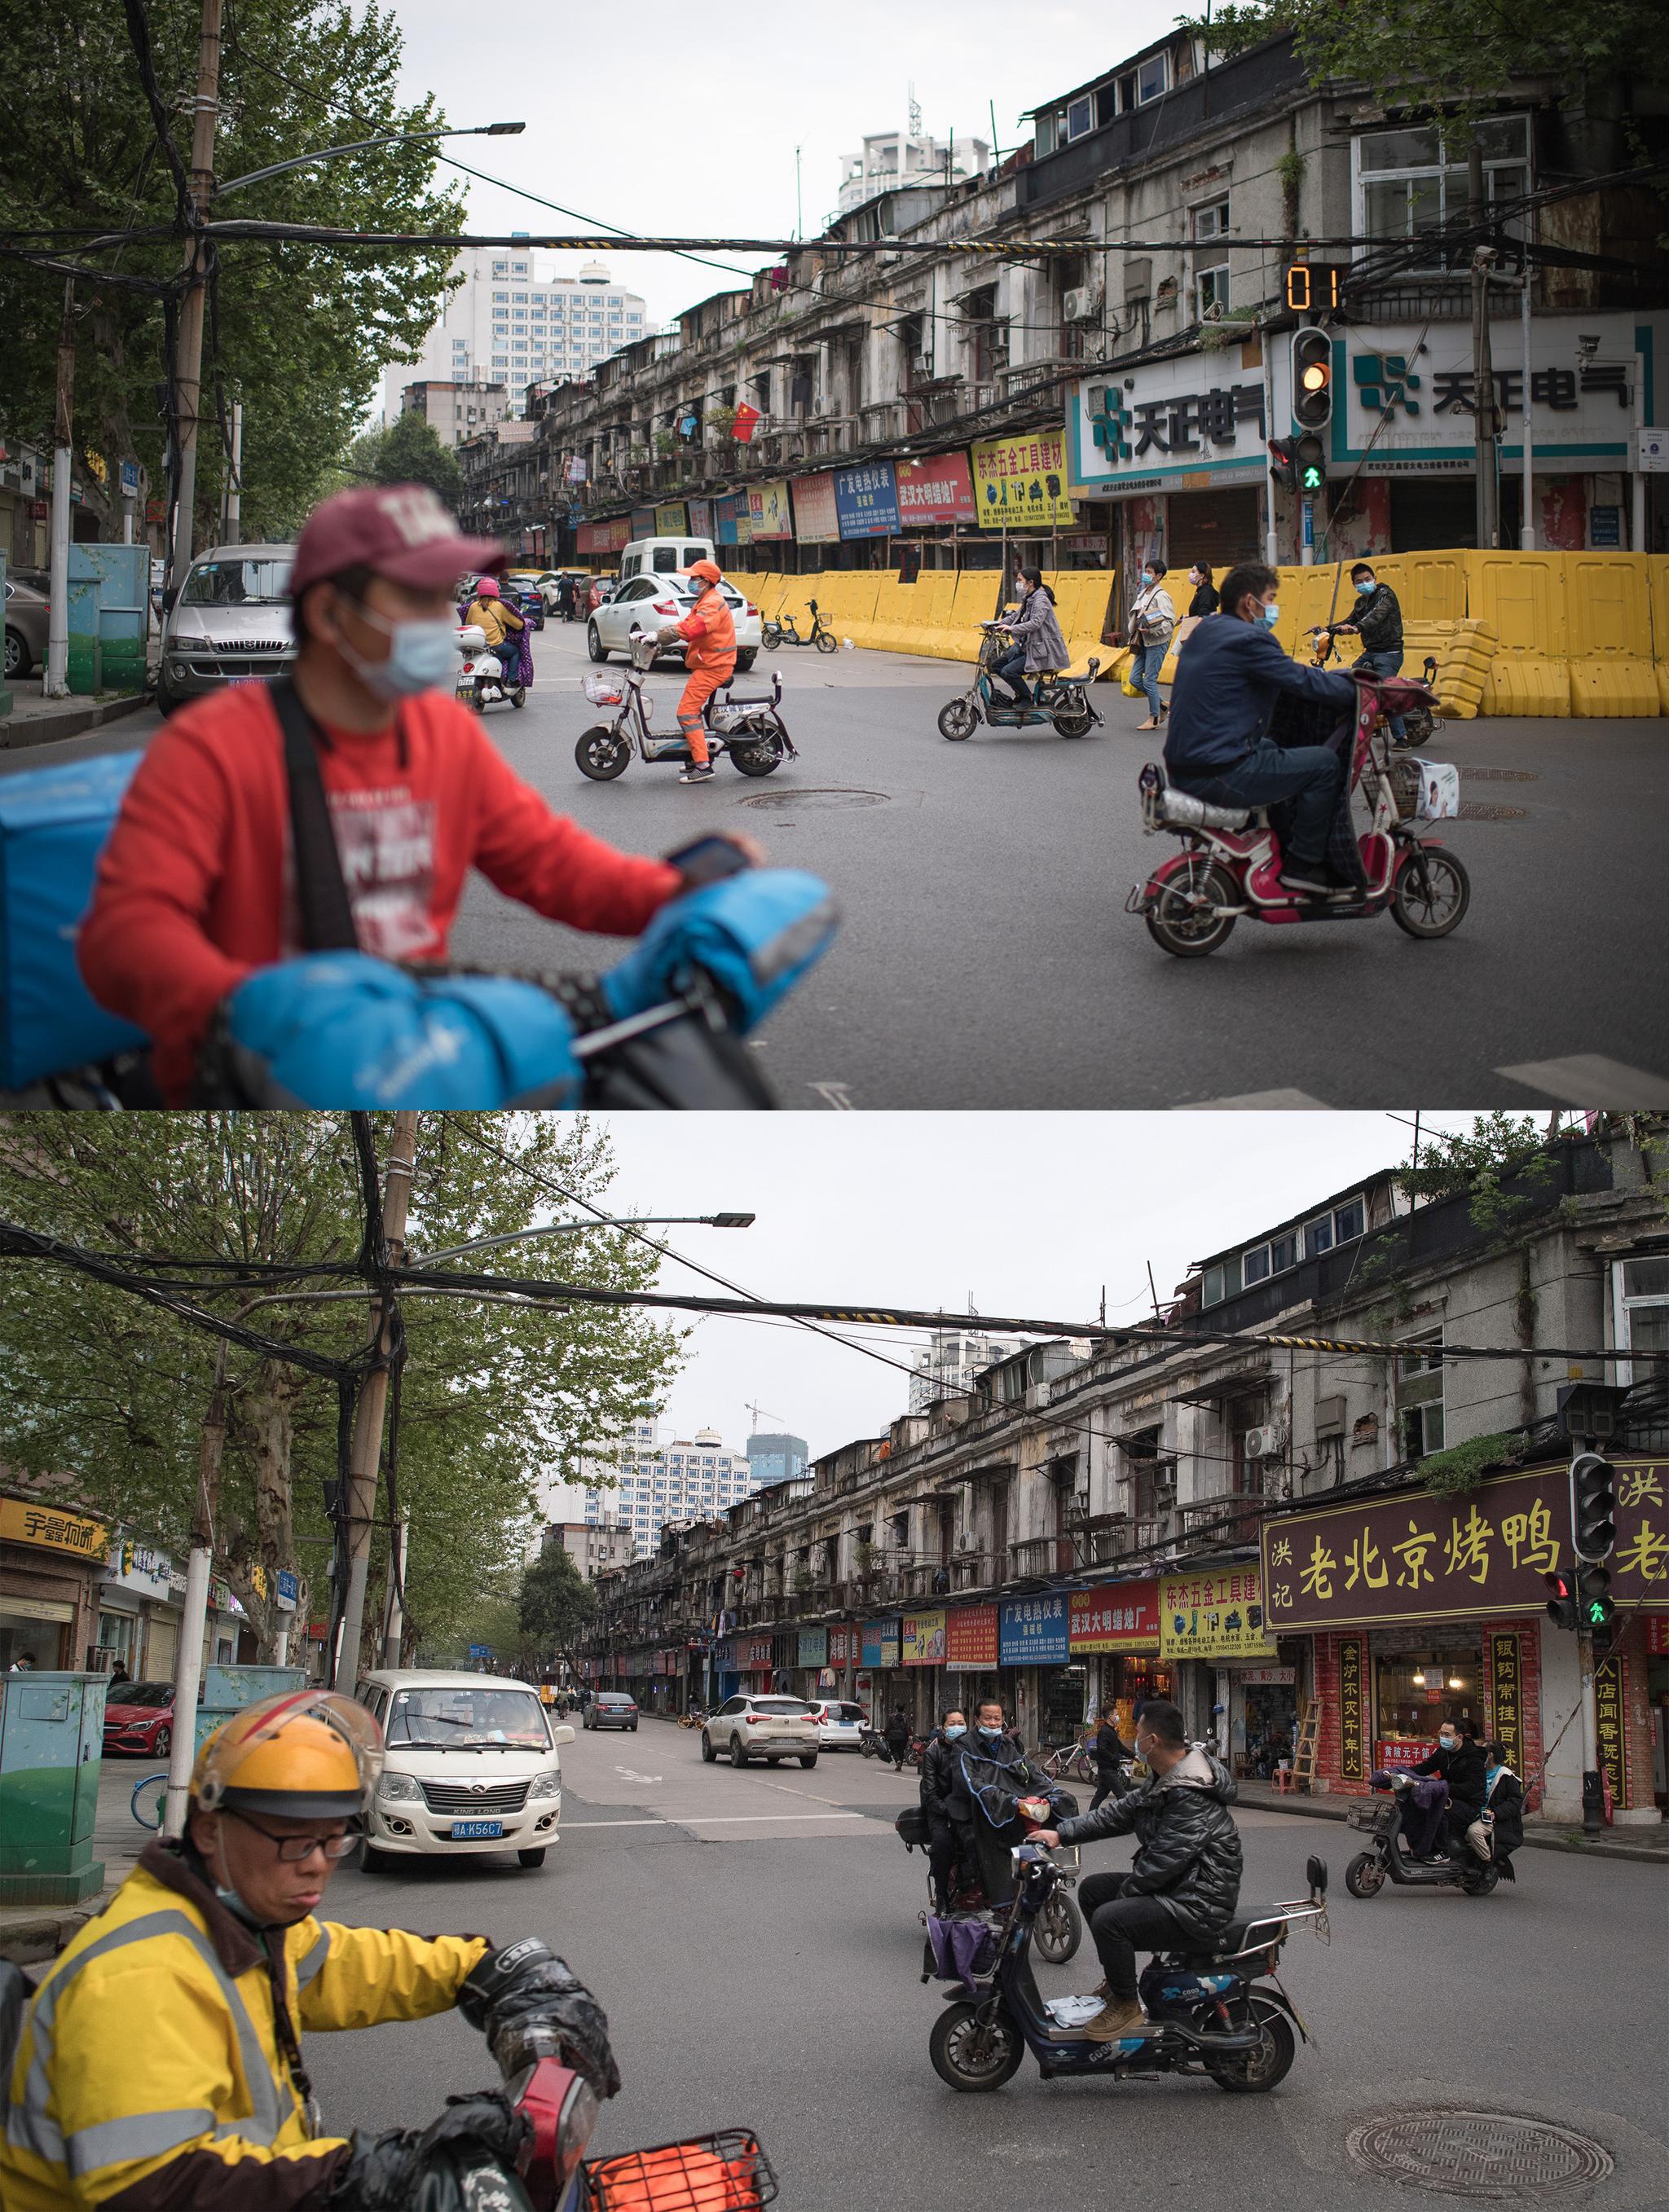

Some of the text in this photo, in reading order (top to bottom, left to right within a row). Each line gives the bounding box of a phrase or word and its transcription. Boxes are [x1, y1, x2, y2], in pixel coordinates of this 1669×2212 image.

[1287, 266, 1338, 310] 01
[1433, 366, 1628, 414] 天正电气
[1134, 383, 1265, 457] 天正电气
[978, 439, 1063, 480] 东杰五金工具建材
[839, 467, 890, 496] 广发电热仪表
[899, 481, 958, 507] 武汉大明蜡烛厂
[1067, 536, 1107, 549] 水泥、黄沙、大
[1617, 1466, 1663, 1509] 洪
[1299, 1497, 1561, 1600] 老北京烤鸭
[1166, 1572, 1262, 1611] 东杰五金工具建
[1271, 1537, 1294, 1609] 洪记
[1005, 1598, 1063, 1624] 广发电热仪表
[1071, 1606, 1147, 1634] 武汉大明蜡烛厂
[1240, 1669, 1296, 1682] 水泥、黄沙、大小
[1344, 1644, 1359, 1773] 金炉不灭千年火
[1384, 1745, 1438, 1760] 黄陂元子简
